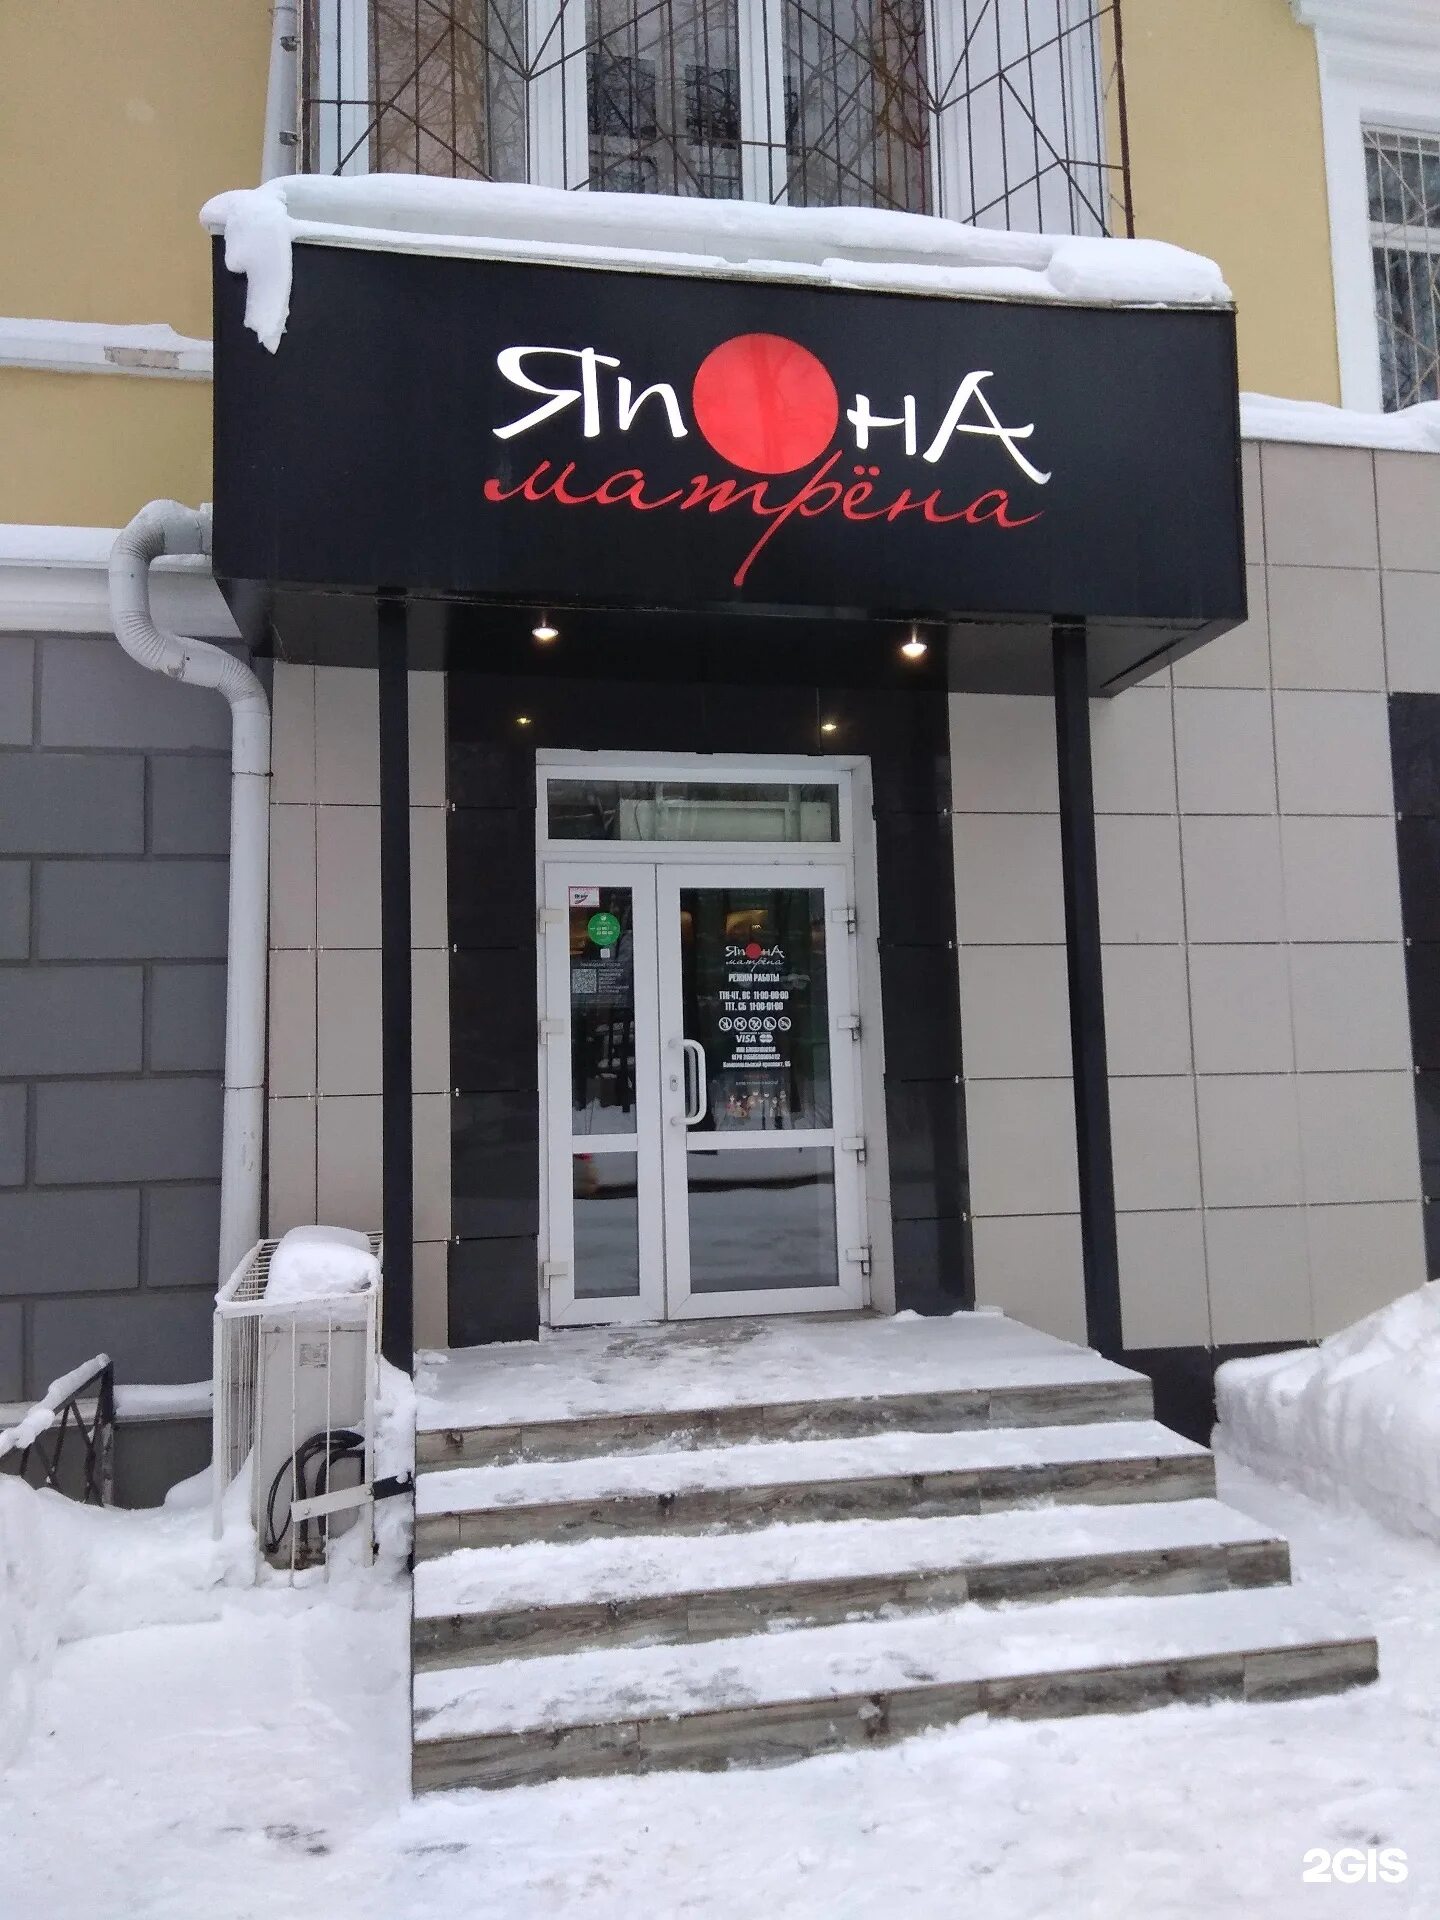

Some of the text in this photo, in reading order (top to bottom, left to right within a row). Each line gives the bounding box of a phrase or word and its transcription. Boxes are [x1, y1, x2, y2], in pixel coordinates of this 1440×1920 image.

[484, 449, 1044, 587] матрёна
[728, 973, 780, 982] РЕЖИМ РАБОТЫ
[742, 990, 751, 1000] ВС
[738, 1002, 747, 1011] СБ
[735, 1034, 757, 1043] VISA
